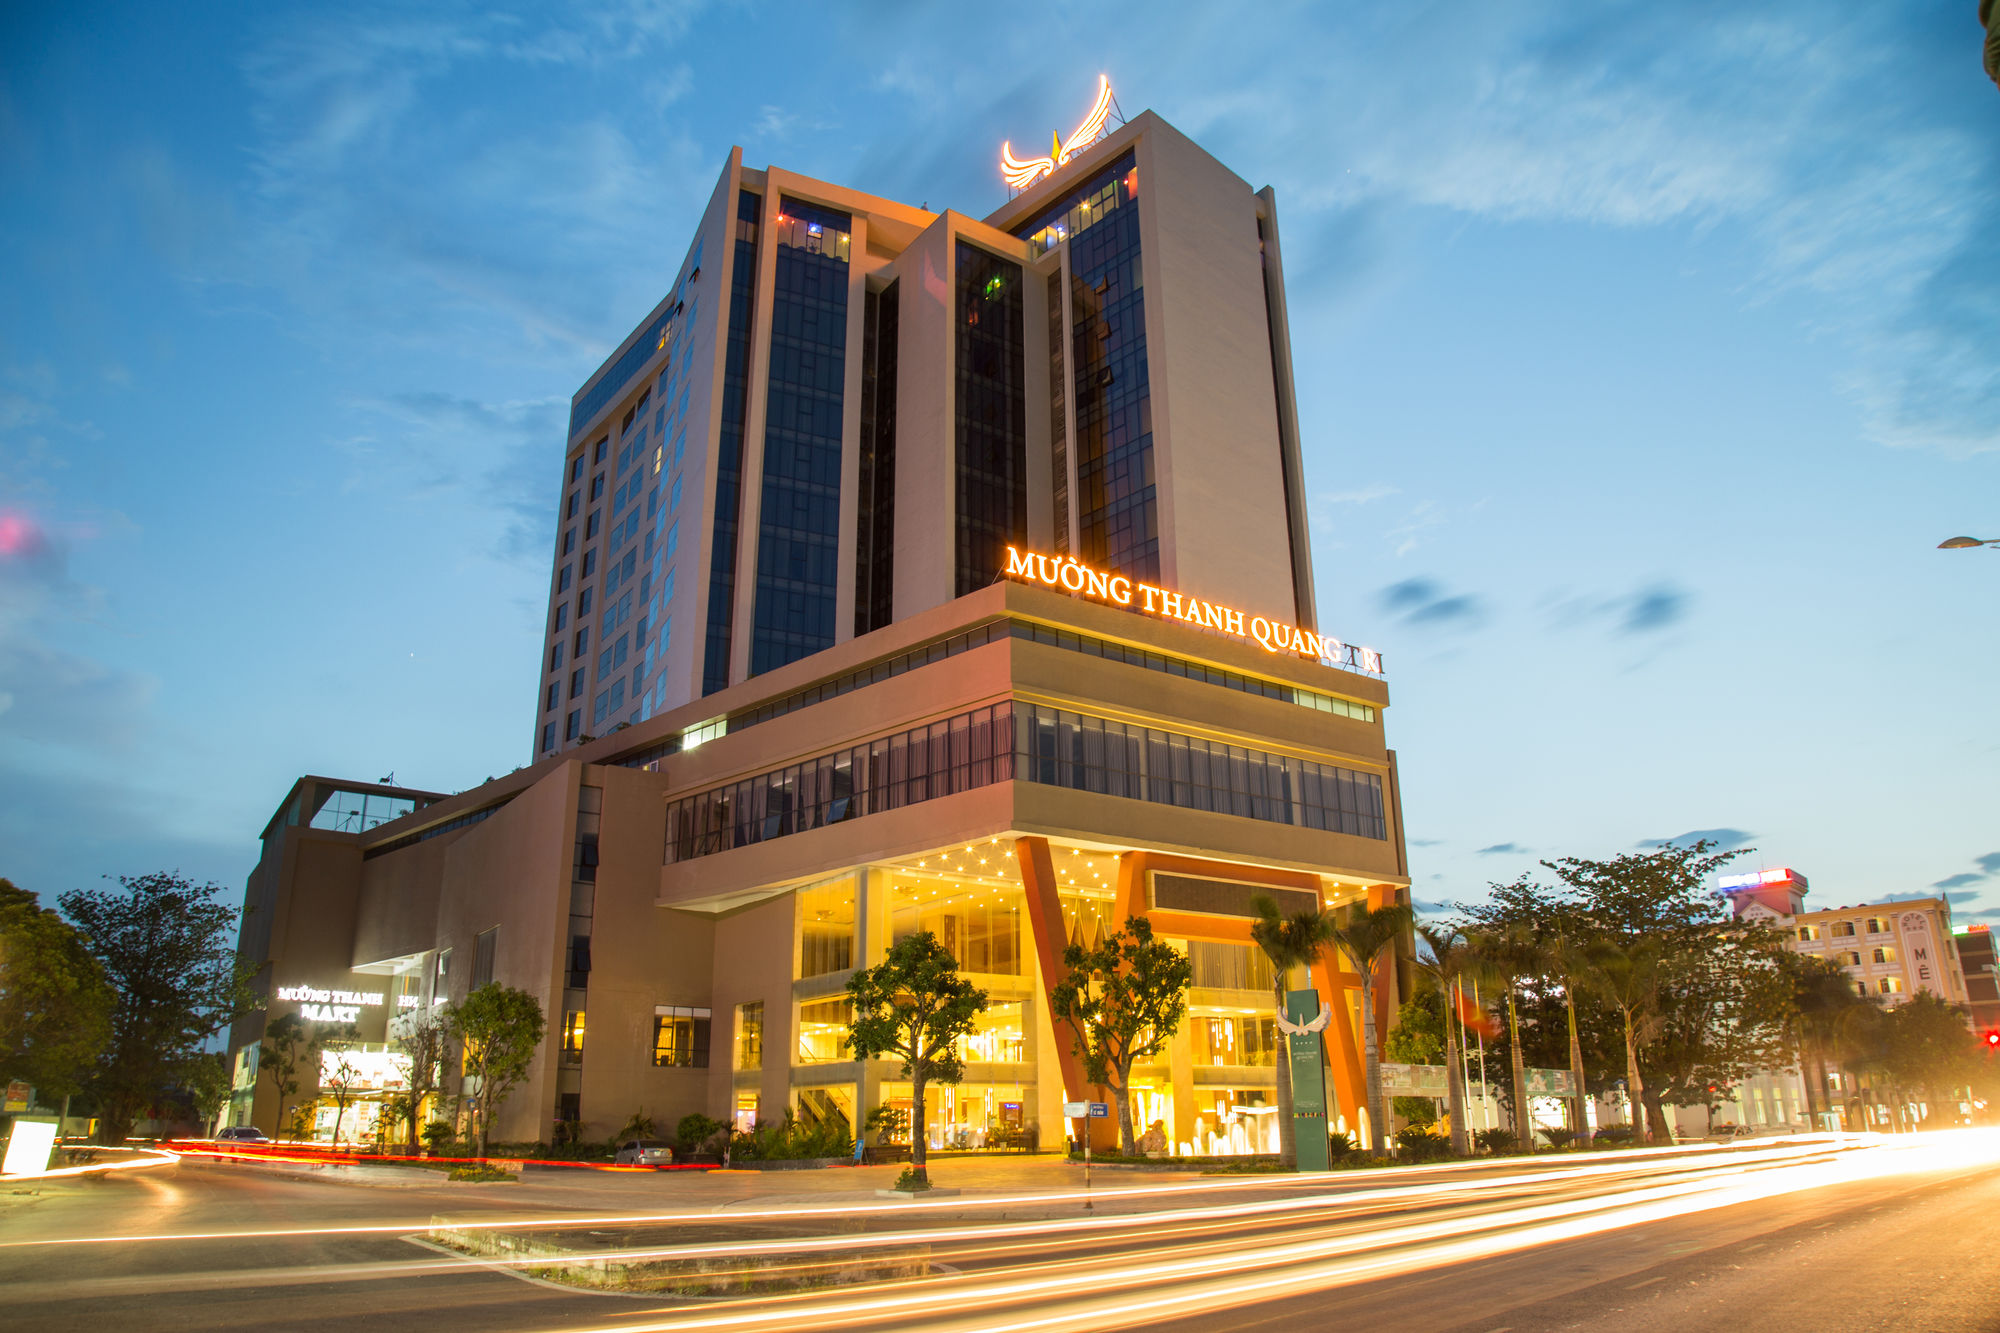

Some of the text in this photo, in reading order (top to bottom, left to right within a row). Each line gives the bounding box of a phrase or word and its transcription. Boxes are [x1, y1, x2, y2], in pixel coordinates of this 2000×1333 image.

[1006, 546, 1132, 605] MƯỜNG
[1138, 583, 1246, 637] THANH
[1250, 616, 1343, 663] QUANG
[331, 990, 384, 1006] THANH
[301, 1004, 360, 1023] MART
